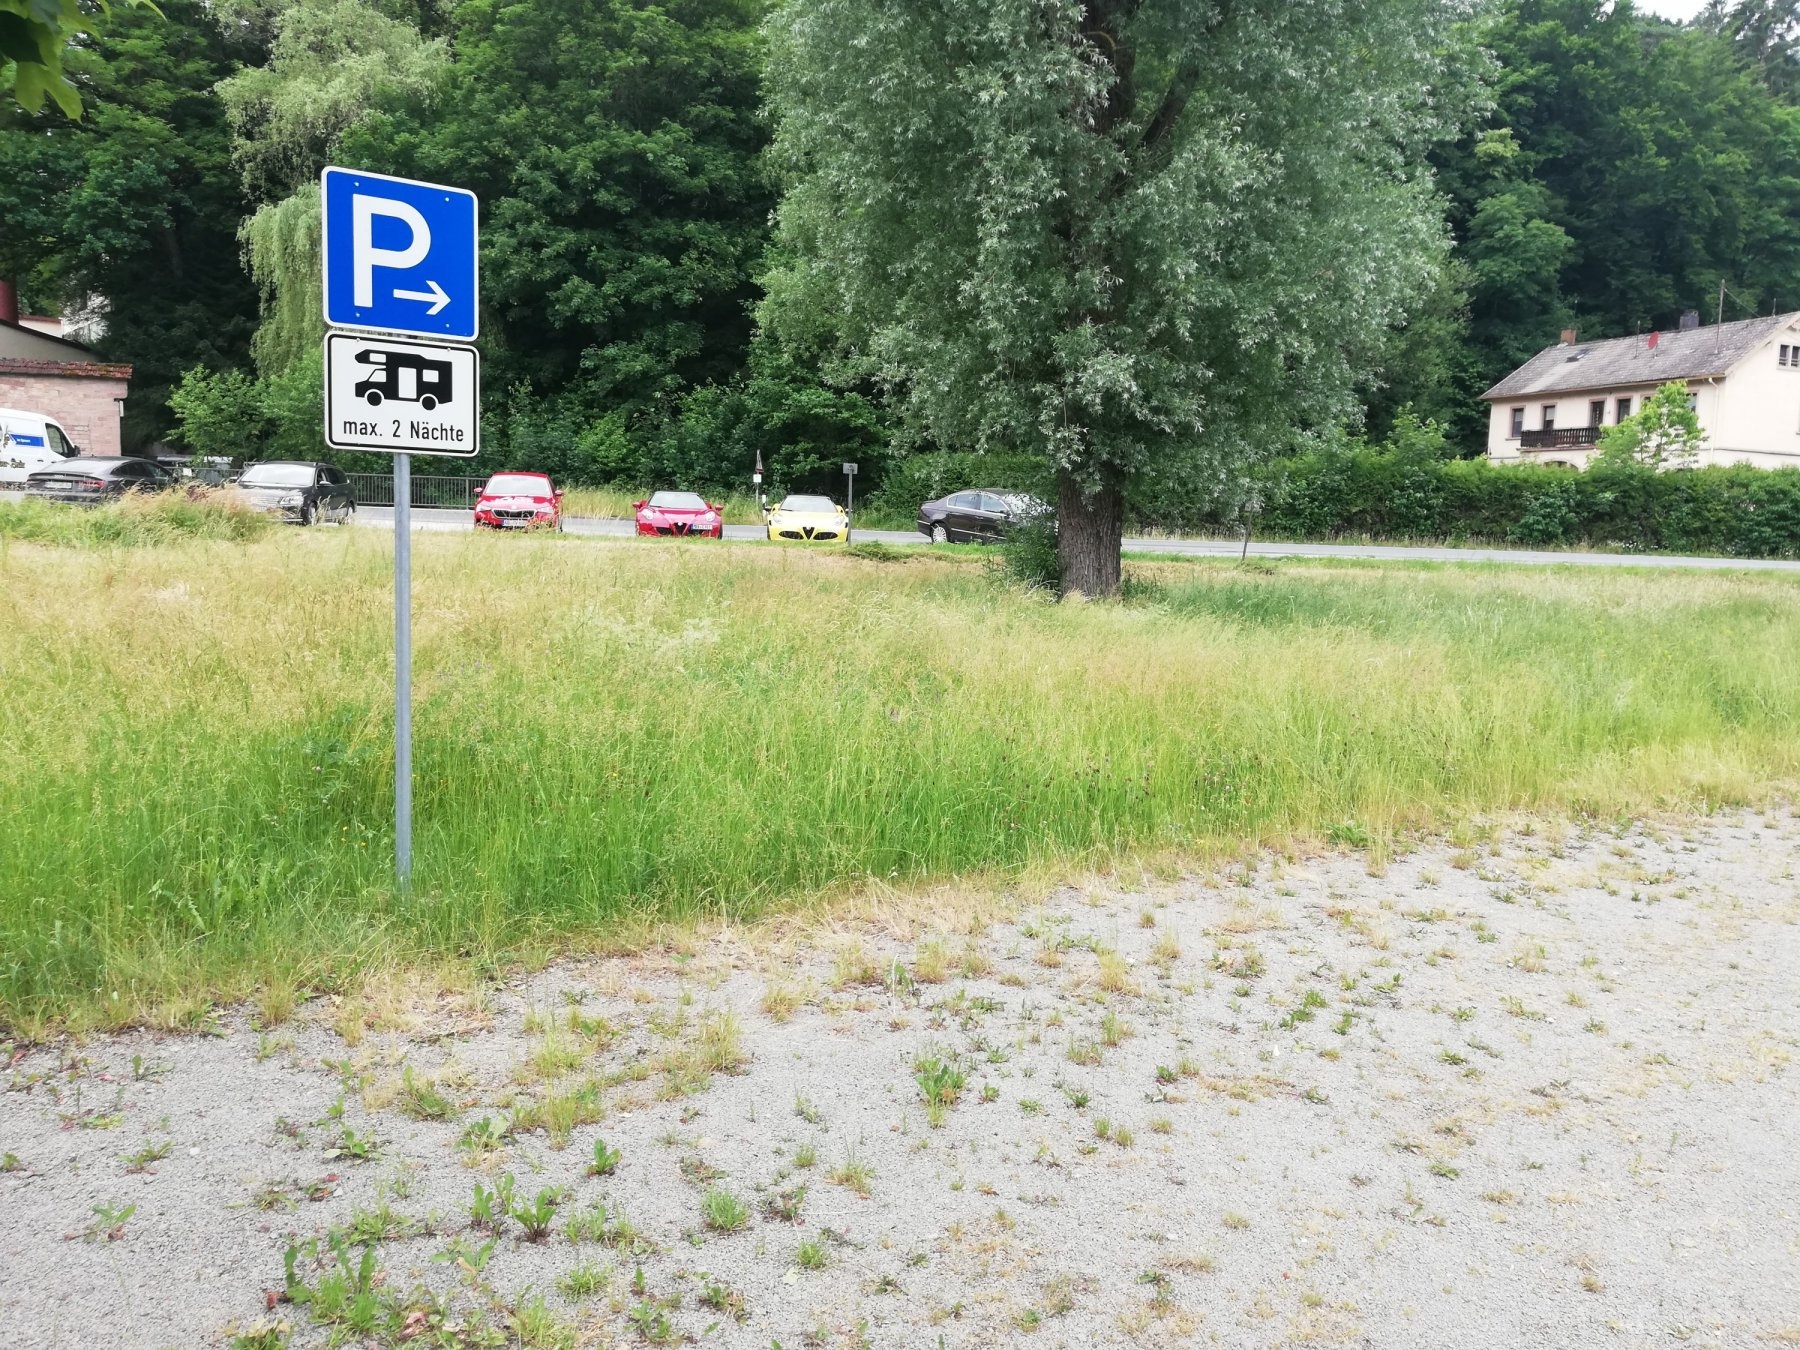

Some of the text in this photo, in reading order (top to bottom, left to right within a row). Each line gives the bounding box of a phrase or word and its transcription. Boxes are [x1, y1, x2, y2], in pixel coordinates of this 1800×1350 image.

[353, 194, 431, 308] P
[344, 420, 464, 442] max. 2 Nächte
